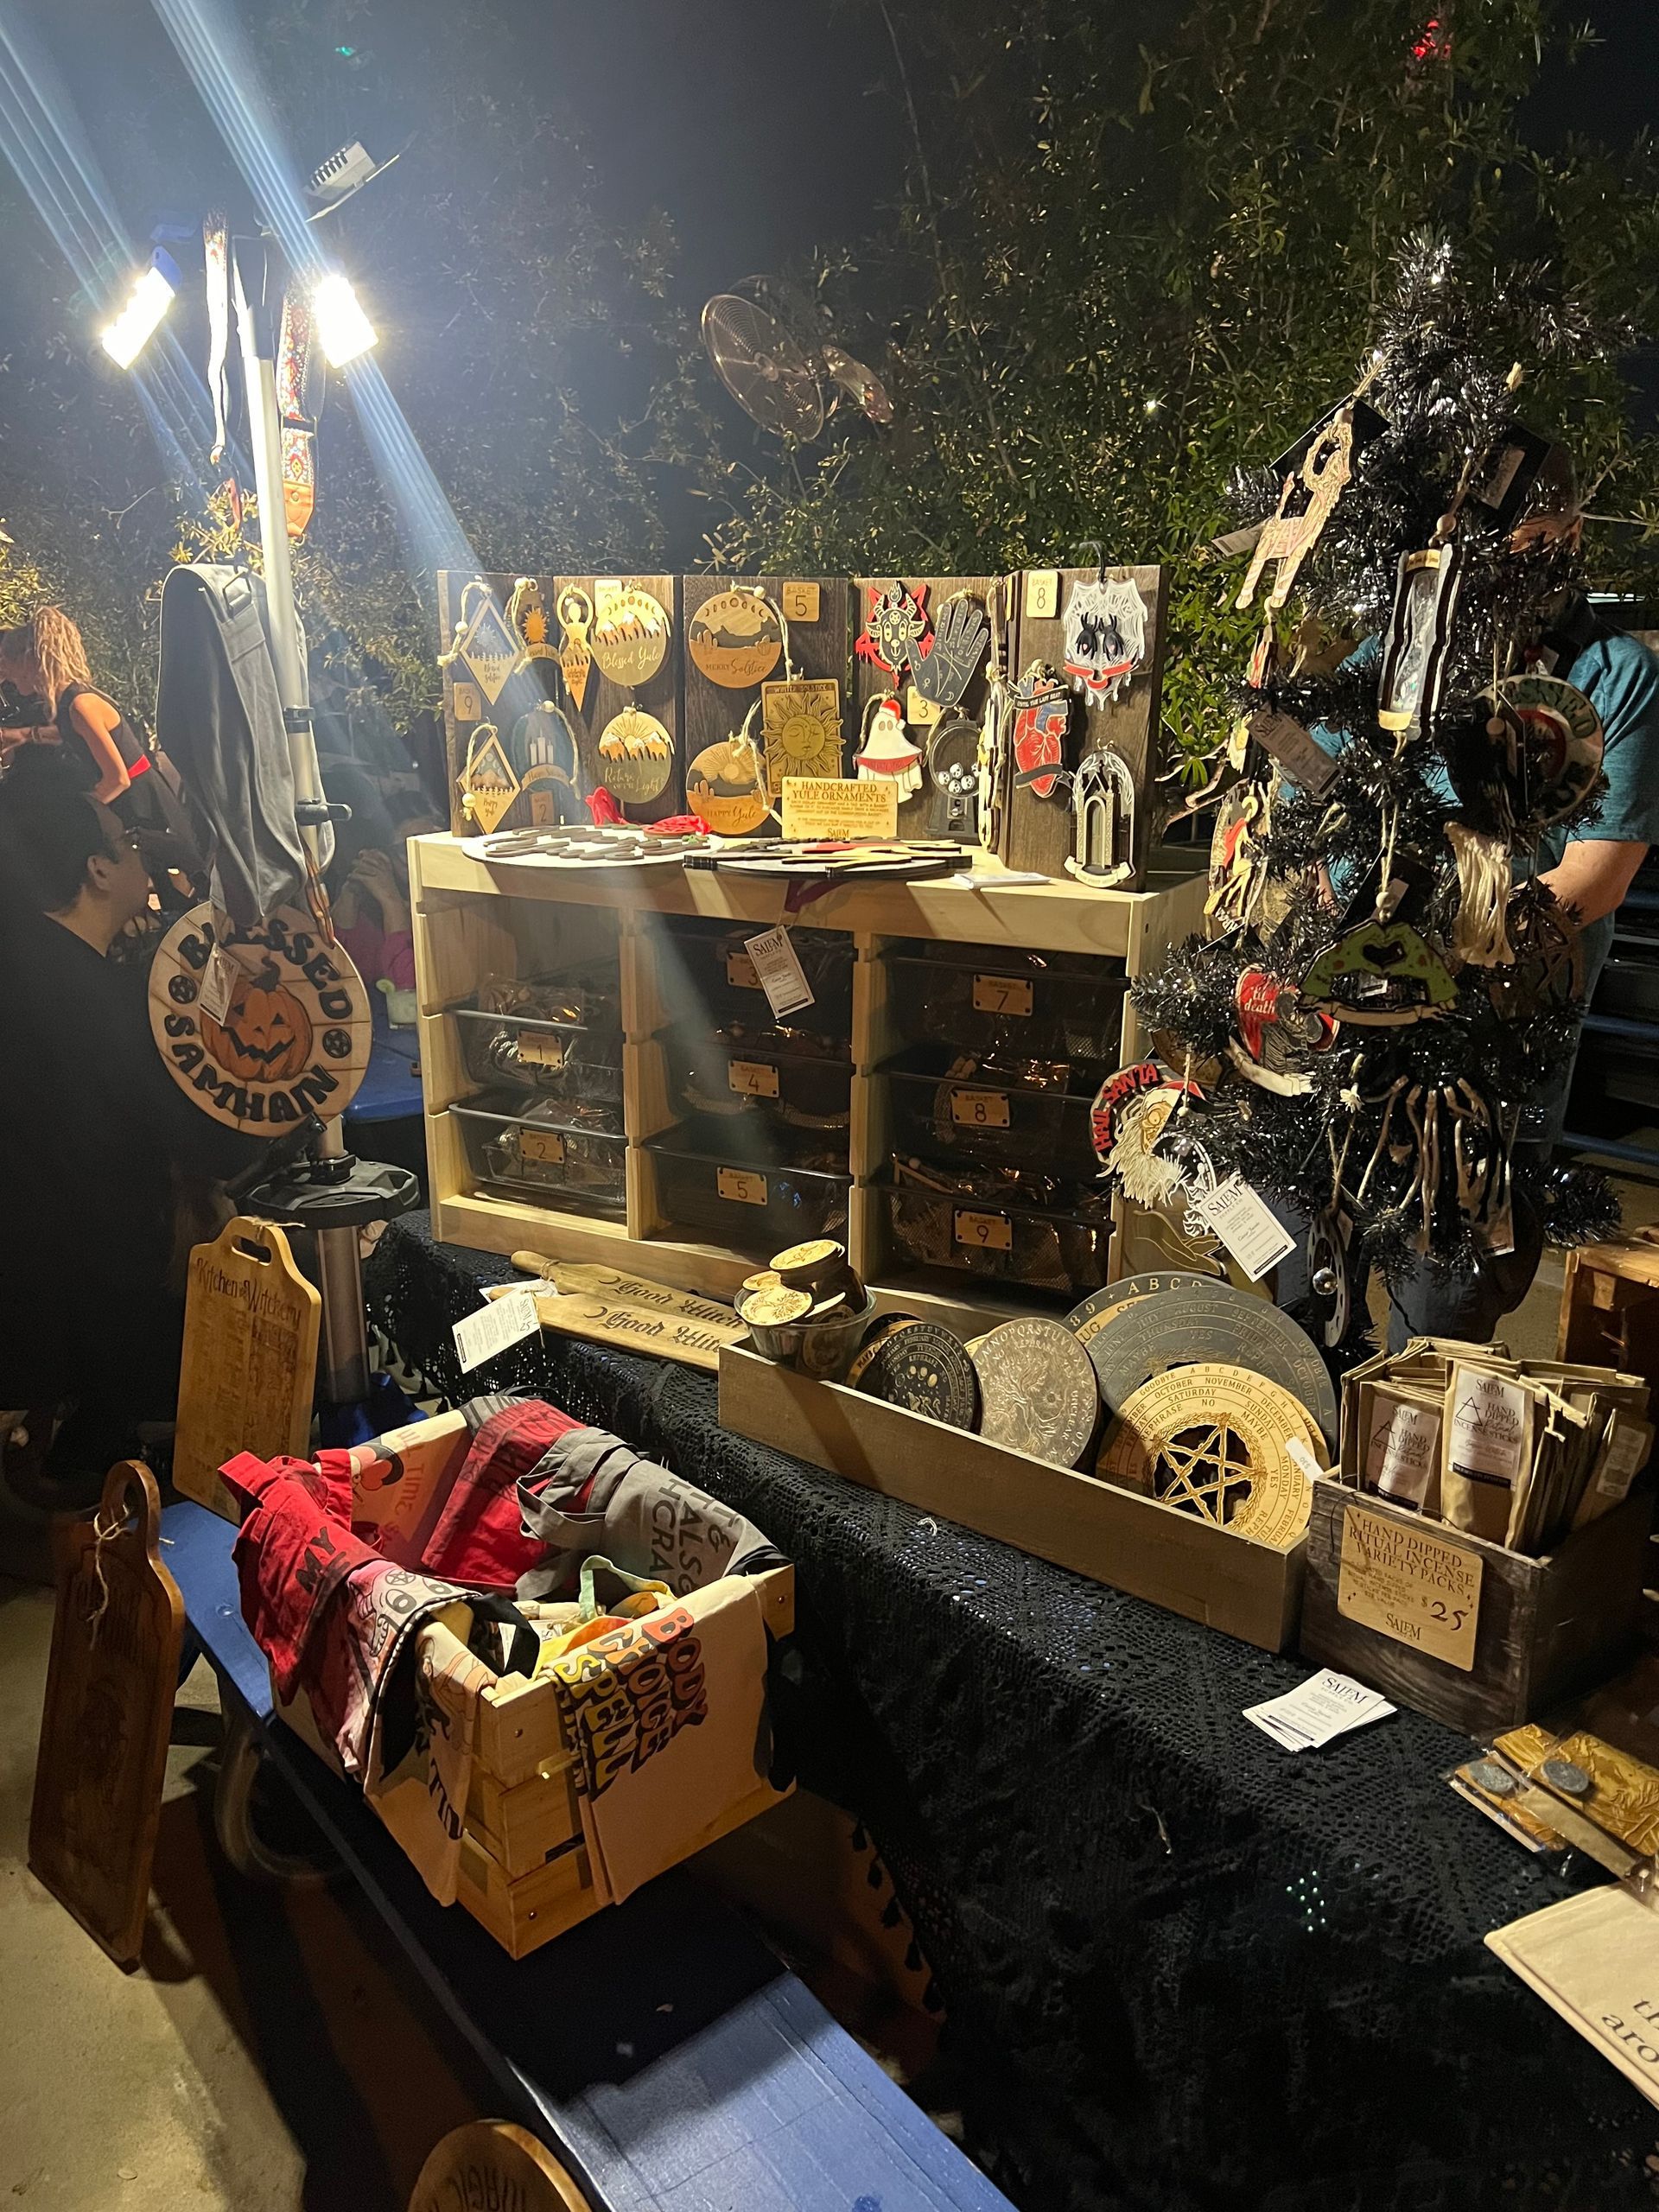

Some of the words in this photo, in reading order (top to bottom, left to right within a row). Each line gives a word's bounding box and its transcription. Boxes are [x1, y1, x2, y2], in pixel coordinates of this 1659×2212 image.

[786, 586, 817, 594] BASKET
[1037, 588, 1046, 609] 8
[795, 595, 807, 616] 5
[602, 651, 633, 670] Blessed
[638, 645, 661, 670] Yule
[730, 658, 766, 677] Solstice
[464, 696, 474, 715] 9
[918, 700, 929, 718] 3
[636, 779, 659, 796] Light
[792, 790, 820, 800] YULE
[822, 791, 887, 803] ORNAMENTS
[802, 781, 877, 792] HANDCRAFTED
[539, 804, 547, 822] 2
[708, 810, 731, 818] HAPPY
[732, 804, 757, 823] Yule
[747, 967, 758, 986] 3
[996, 989, 1009, 1010] 7
[1249, 985, 1267, 1002] 'til
[1243, 996, 1276, 1015] death
[537, 1044, 543, 1060] 1
[164, 1014, 339, 1122] SAMHAIN
[748, 1073, 760, 1092] 4
[975, 1103, 987, 1122] 8
[1091, 1108, 1113, 1154] HAIL
[1102, 1064, 1160, 1106] SANTA
[537, 1141, 546, 1159] 2
[737, 1181, 748, 1199] 5
[1207, 1184, 1243, 1217] SALEM
[976, 1224, 988, 1243] 9
[197, 1257, 238, 1299] Kitchen
[244, 1279, 301, 1332] Witchery
[609, 1281, 673, 1306] Good
[677, 1299, 744, 1329] Witch
[1071, 1315, 1081, 1326] 8
[1085, 1302, 1096, 1313] 9
[1128, 1281, 1140, 1295] A
[1149, 1278, 1160, 1291] B
[1170, 1277, 1181, 1290] C
[596, 1311, 665, 1337] Good
[1140, 1318, 1200, 1341] THURSDAY
[1232, 1325, 1274, 1352] FRIDAY
[1188, 1330, 1215, 1341] YES
[1119, 1342, 1158, 1376] MAYBE
[1174, 1303, 1219, 1316] AUGUST
[1231, 1309, 1287, 1351] SEPTEMBER
[1293, 1358, 1318, 1412] OCTOBER
[993, 1349, 1005, 1361] NO
[1014, 1339, 1055, 1354] REPHRASE
[1062, 1390, 1079, 1440] UNCLEAR
[1141, 1372, 1176, 1396] GOODBYE
[1476, 1378, 1505, 1398] SALEM
[1154, 1378, 1193, 1399] OCTOBER
[1205, 1376, 1252, 1396] NOVEMBER
[1260, 1397, 1294, 1440] DECEMBER
[1392, 1404, 1418, 1426] SALEM
[1484, 1409, 1519, 1427] DIPPED
[1488, 1402, 1516, 1417] HAND
[1401, 1428, 1427, 1444] HAND
[1454, 1419, 1487, 1434] INCENSE
[1489, 1431, 1519, 1444] STICKS
[1140, 1404, 1184, 1442] REPHRASE
[1241, 1410, 1268, 1440] MAYBE
[1270, 1470, 1279, 1489] YES
[1167, 1389, 1217, 1404] SATURDAY
[1244, 1401, 1277, 1432] SUNDAY
[1280, 1455, 1288, 1501] MONDAY
[1398, 1435, 1430, 1452] DIPPED
[1363, 1518, 1404, 1545] HAND
[1408, 1537, 1462, 1568] DIPPED
[1349, 1526, 1402, 1557] RITUAL
[1406, 1549, 1474, 1587] INCENSE
[1357, 1541, 1418, 1575] VARIETY
[1421, 1568, 1464, 1596] PACKS
[1430, 1600, 1469, 1631] 25
[1385, 1613, 1421, 1641] SALEM
[642, 1607, 709, 1726] BODY
[1322, 1677, 1370, 1704] SALEM
[555, 1652, 636, 1802] SPELL
